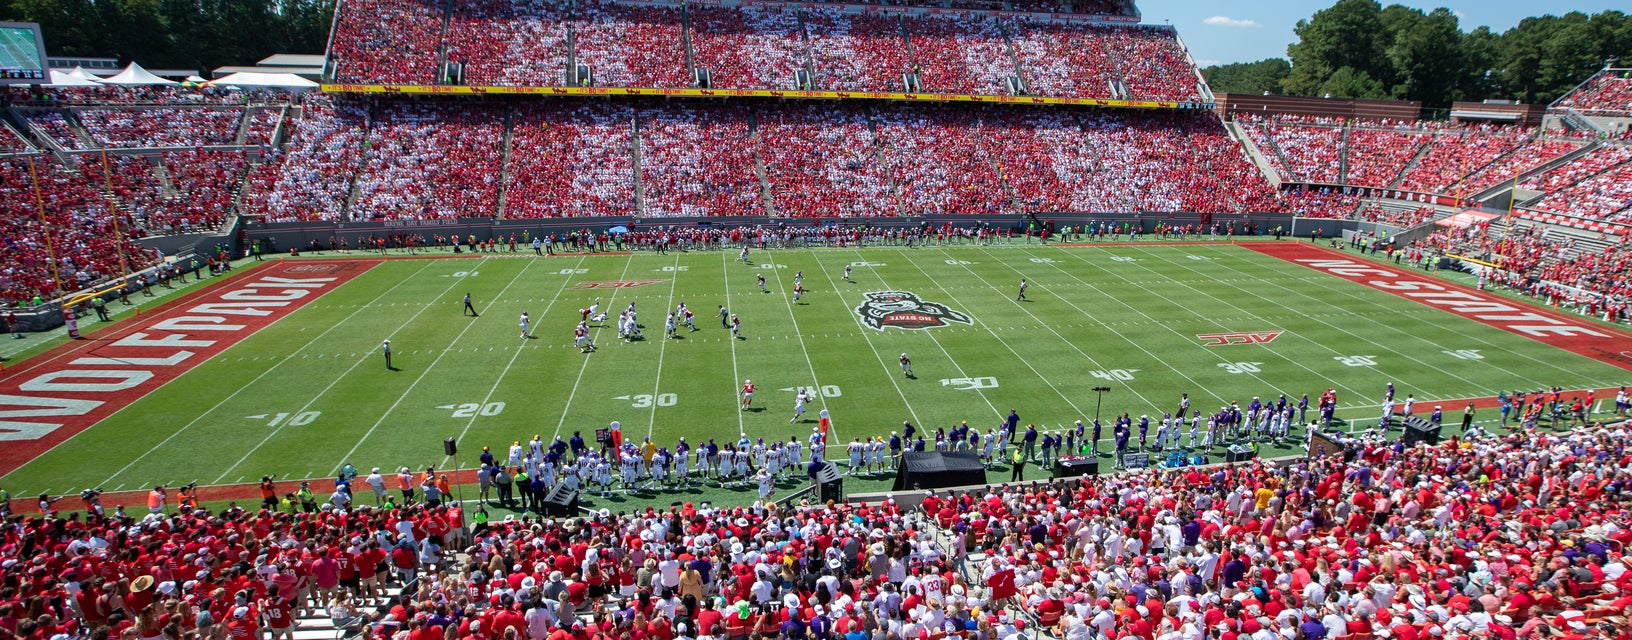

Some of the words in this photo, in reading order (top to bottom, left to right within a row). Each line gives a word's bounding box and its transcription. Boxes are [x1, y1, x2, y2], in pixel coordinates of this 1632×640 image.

[1342, 186, 1438, 204] WOFPACK
[1294, 258, 1398, 277] NC
[1369, 280, 1612, 338] STATE
[1197, 330, 1284, 346] ACC
[1334, 354, 1377, 367] 20
[1442, 349, 1485, 360] 10
[1217, 362, 1262, 374] 30
[1088, 369, 1135, 381] 40
[797, 384, 842, 398] 40
[632, 393, 677, 408] 30
[451, 402, 506, 418] 20
[267, 411, 322, 427] 10
[470, 587, 478, 596] 12
[928, 580, 939, 592] 33
[268, 608, 281, 618] 18
[820, 622, 825, 633] 1
